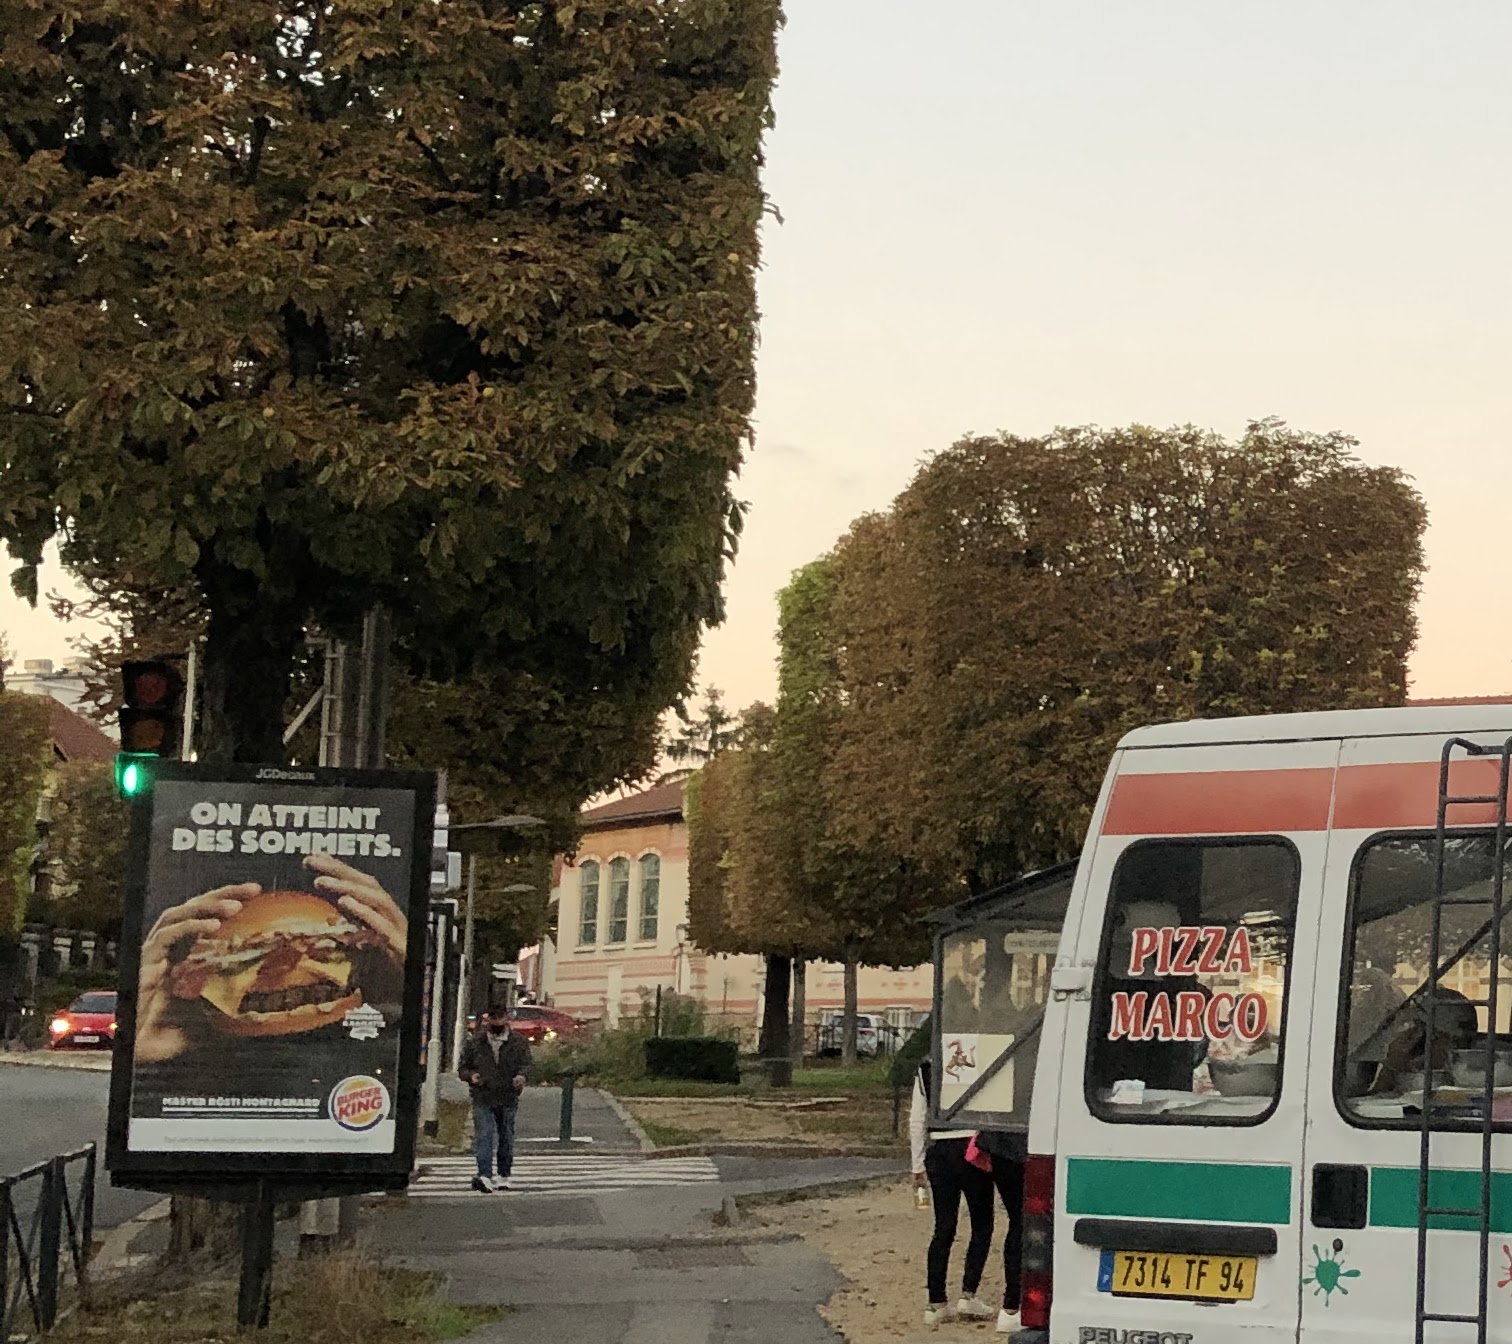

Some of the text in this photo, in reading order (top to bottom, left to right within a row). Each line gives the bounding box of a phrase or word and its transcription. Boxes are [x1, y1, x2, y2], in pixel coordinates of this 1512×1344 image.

[255, 768, 316, 781] JCDecaux
[190, 802, 381, 830] ON ATTEINT
[172, 827, 402, 857] DES SOMMETS.
[1128, 926, 1252, 976] PIZZA
[1108, 991, 1268, 1042] MARCO
[337, 1087, 382, 1106] BURGER
[338, 1097, 383, 1120] KING
[1122, 1255, 1245, 1293] 7314 TF 94
